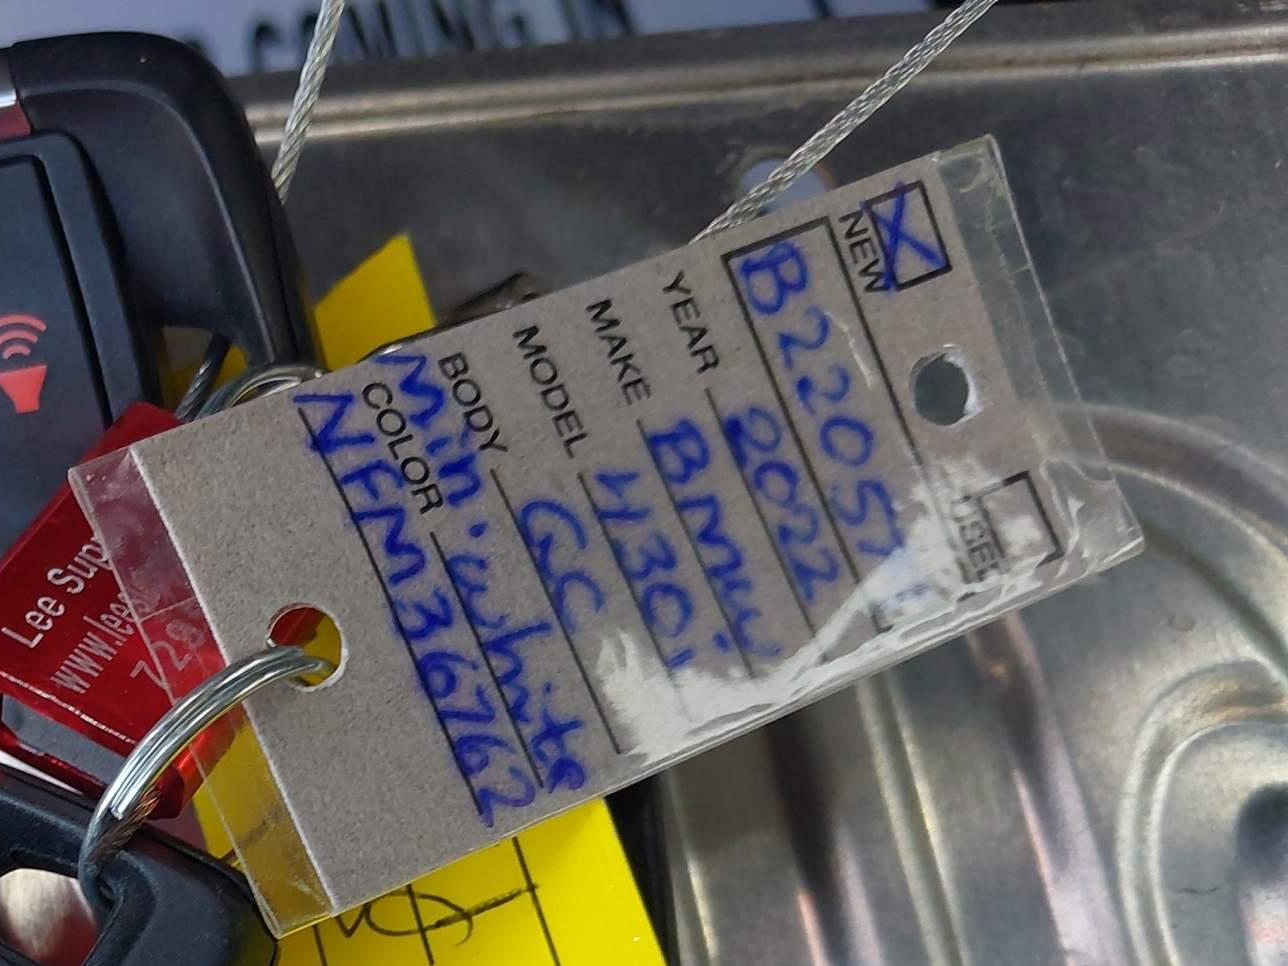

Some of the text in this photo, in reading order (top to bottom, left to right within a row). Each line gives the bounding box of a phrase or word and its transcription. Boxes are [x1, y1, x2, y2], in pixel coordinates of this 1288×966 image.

[838, 211, 892, 293] NEW
[585, 299, 651, 406] MAKE
[663, 270, 720, 374] YEAR
[362, 382, 444, 514] COLOR
[439, 352, 508, 453] BODY
[512, 325, 587, 459] MODEL
[739, 238, 928, 608] B22057
[725, 406, 840, 603] 2022
[1, 536, 114, 649] Lee Sup
